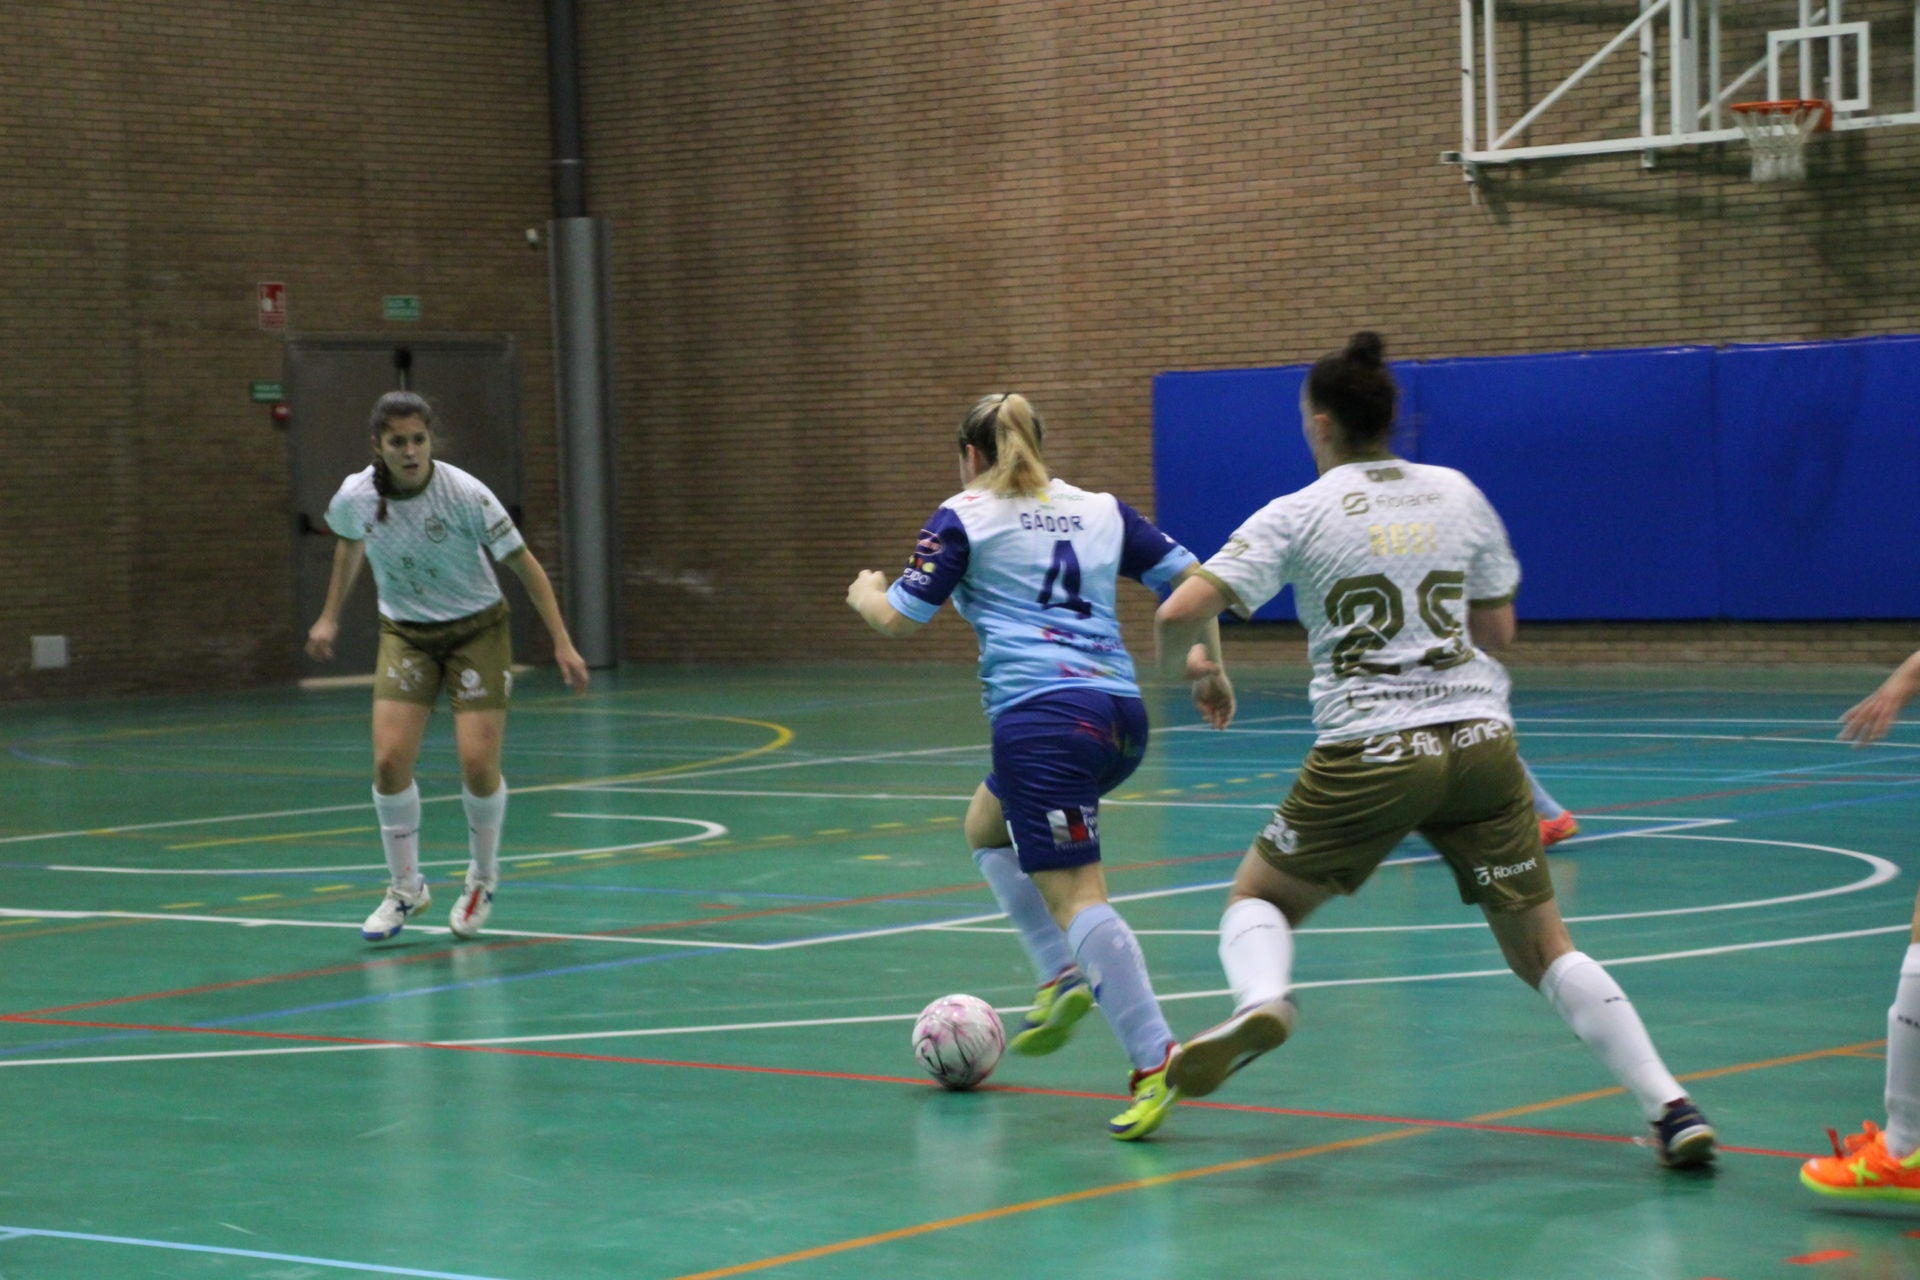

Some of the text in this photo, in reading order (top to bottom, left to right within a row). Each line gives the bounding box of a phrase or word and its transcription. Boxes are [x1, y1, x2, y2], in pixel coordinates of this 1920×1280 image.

[1020, 510, 1084, 533] GÁDOR
[1036, 540, 1092, 619] 4
[1493, 857, 1538, 880] fibranet
